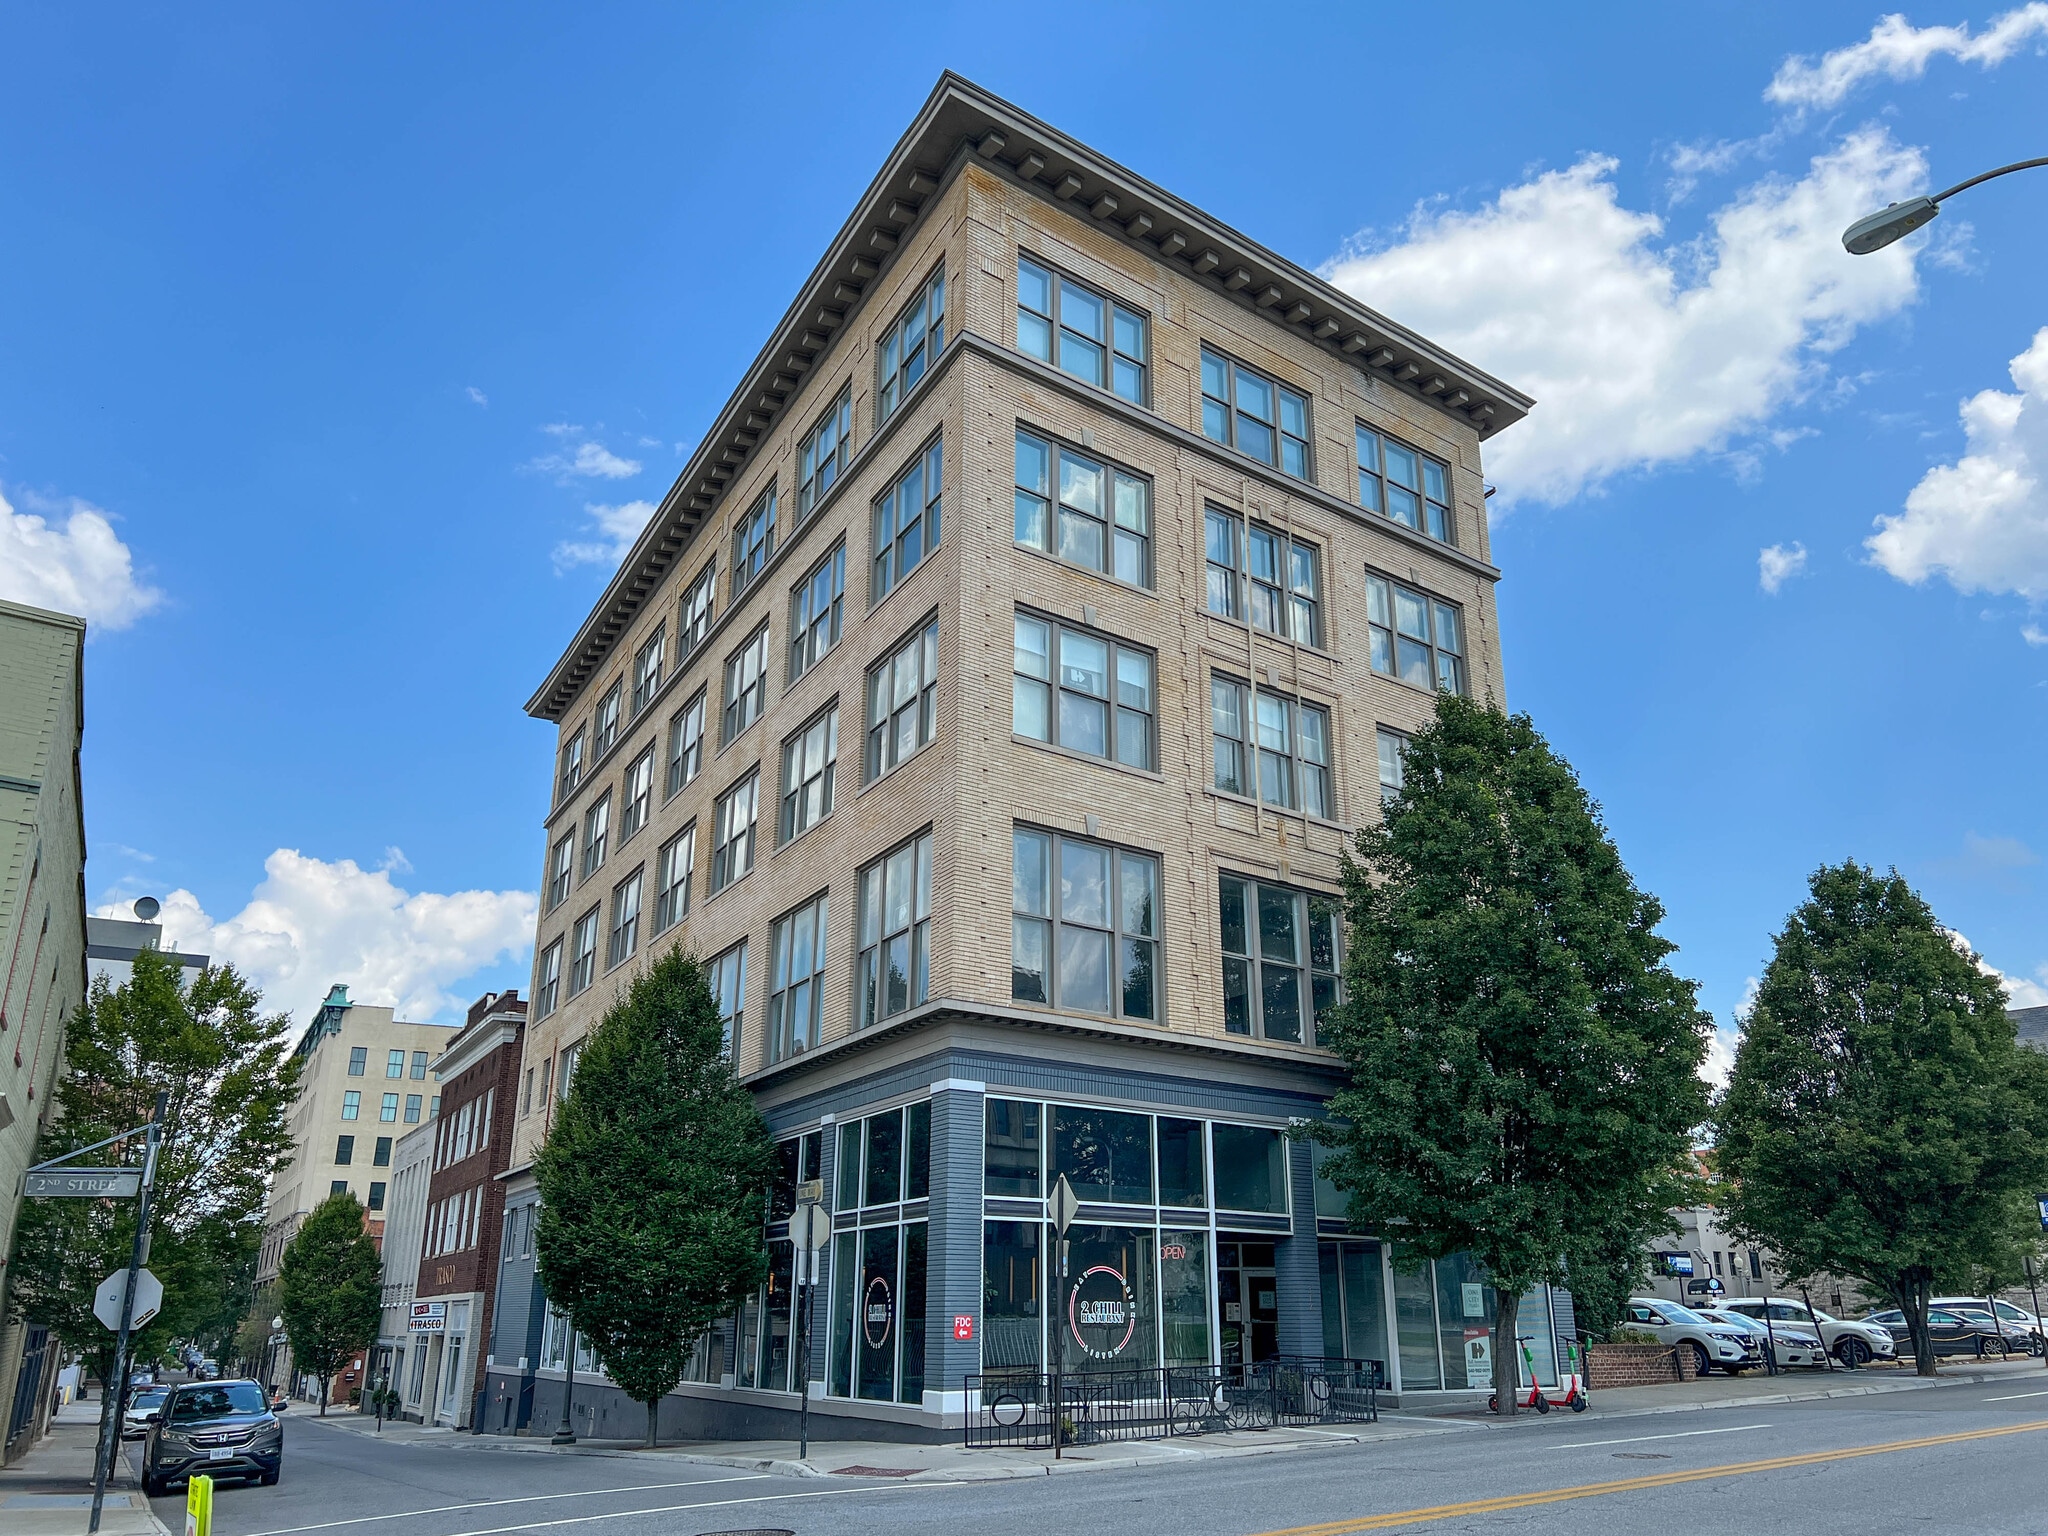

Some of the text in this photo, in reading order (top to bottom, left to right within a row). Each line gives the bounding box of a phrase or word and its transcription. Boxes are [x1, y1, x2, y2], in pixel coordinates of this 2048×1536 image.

[36, 1179, 124, 1191] 2ND STREE
[1160, 1246, 1185, 1260] OPEN
[1081, 1301, 1123, 1314] 2 CHILL
[955, 1317, 971, 1327] FDC
[1081, 1313, 1125, 1323] RESTAURANT
[414, 1319, 441, 1330] TRASCO
